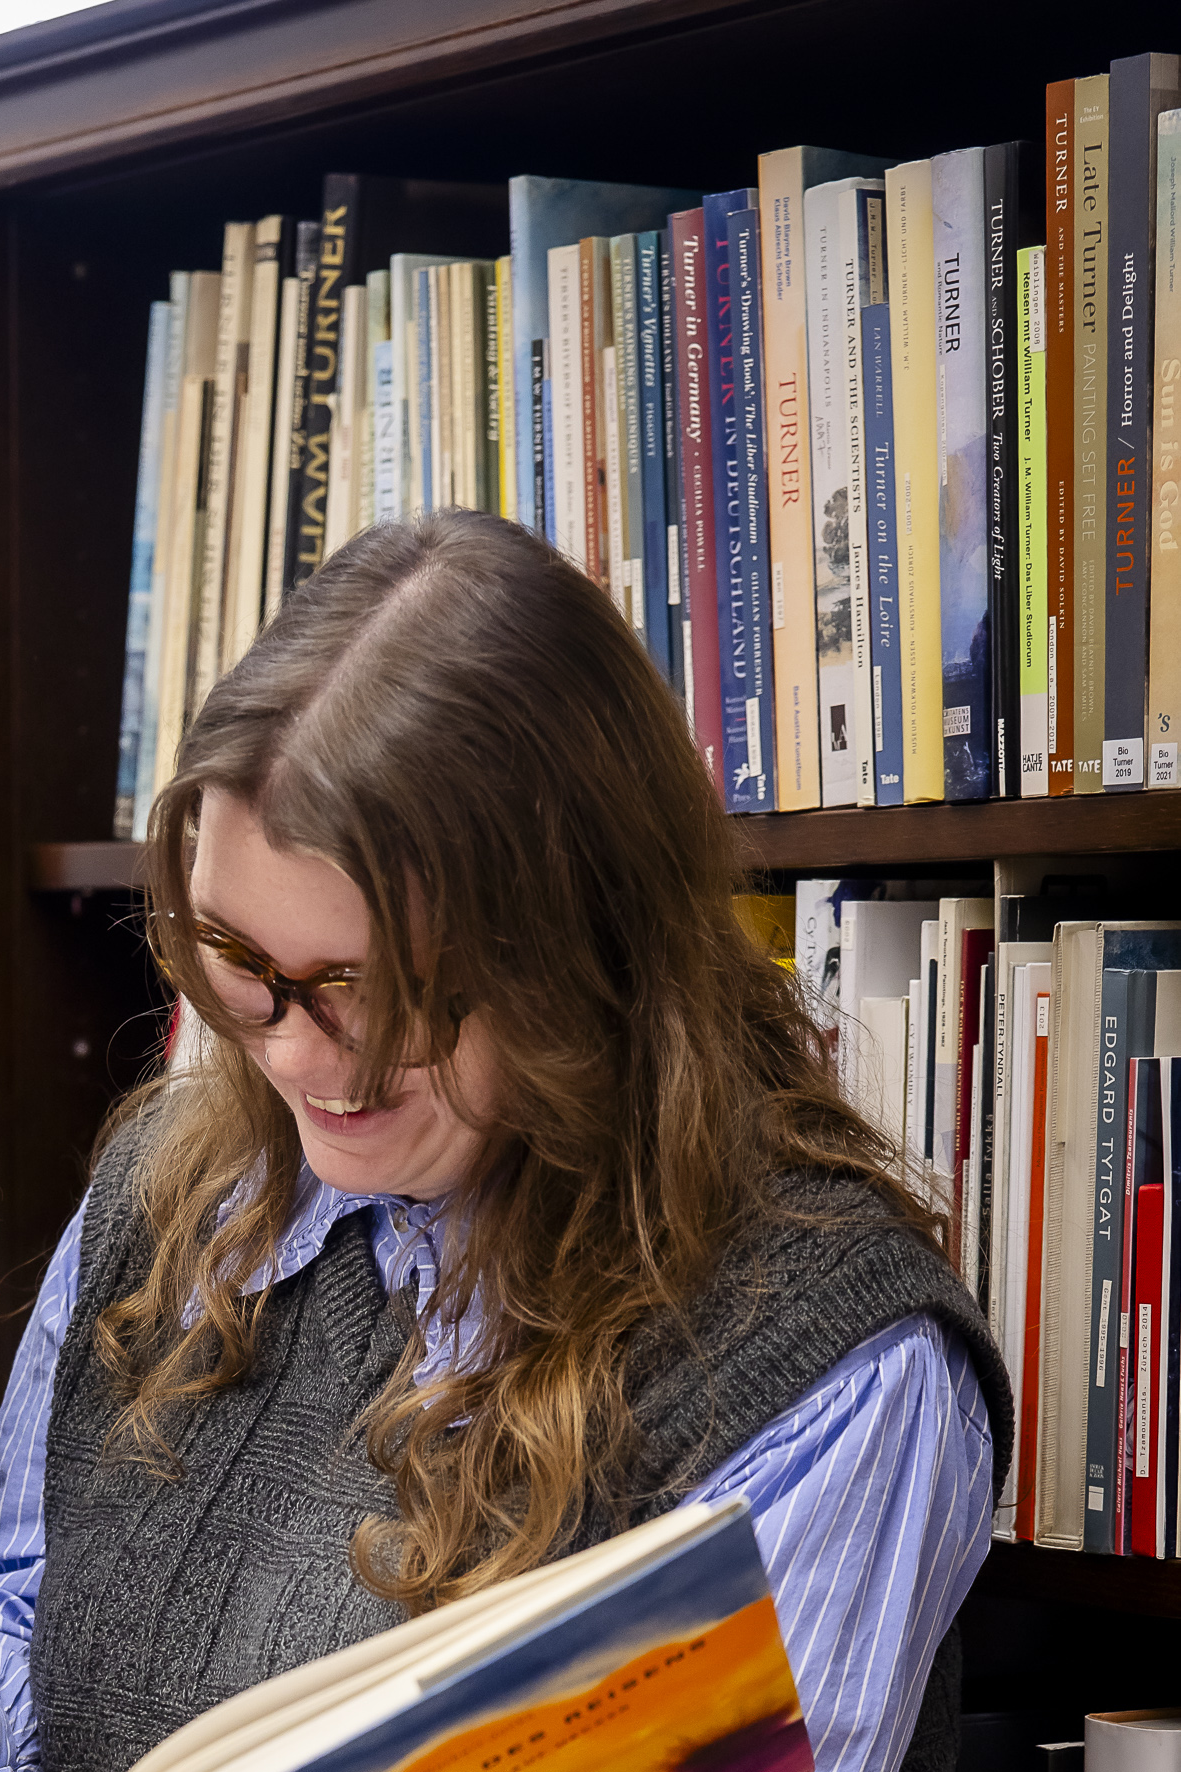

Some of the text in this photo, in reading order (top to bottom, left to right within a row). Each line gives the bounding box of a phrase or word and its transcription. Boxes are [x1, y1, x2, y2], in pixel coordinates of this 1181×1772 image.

[1080, 114, 1104, 126] Exhibition
[1082, 106, 1091, 117] The
[1055, 112, 1068, 214] TURNER
[774, 224, 783, 260] Albrecht
[783, 196, 792, 288] David Blayney Brown
[990, 198, 1004, 292] TURNER
[1168, 156, 1178, 293] Joseph Mallord William Turner
[739, 228, 751, 289] Turner's
[775, 261, 784, 302] Schröder
[1032, 252, 1041, 314] Waiblingen
[308, 206, 348, 406] TURNER
[641, 244, 657, 389] Turner's Vignettes
[819, 225, 832, 408] TURNER IN INDIANAPOLIS
[901, 272, 910, 348] WILLIAM TURNER
[943, 252, 960, 354] TURNER
[991, 318, 1005, 421] SCHOBER
[1081, 140, 1103, 542] Late Turner PAINTING SET FREE
[682, 235, 706, 574] Turner in Germany POWELL
[744, 402, 758, 433] The
[1115, 252, 1137, 596] TURNER Horror and Delight
[746, 435, 760, 471] Liber
[778, 371, 800, 509] TURNER
[845, 258, 865, 669] TURNER AND THE SCIENTISTS James Hamilton
[992, 432, 1004, 461] Two
[1157, 357, 1181, 554] Sun is God
[873, 326, 894, 648] IAN WARRELL Turner on the Loire
[992, 465, 1004, 522] Creators
[1022, 271, 1034, 668] Reisen mit William Turner M. William Turner: Das Liber Studiorum
[748, 473, 762, 545] Studiorum
[992, 525, 1004, 539] of
[1058, 528, 1065, 543] BY
[726, 459, 748, 679] DEUTSCHLAND
[992, 544, 1005, 581] Light
[1058, 547, 1066, 583] DAVID
[751, 571, 760, 622] GILLIAN
[1058, 587, 1066, 630] SOLKIN
[1087, 607, 1095, 636] DAVID
[753, 626, 763, 696] FORRESTER
[1049, 621, 1057, 663] London
[792, 684, 803, 791] Bank Austria Kunstforum
[1022, 752, 1043, 766] HATJE
[1051, 759, 1073, 773] TATE
[1112, 756, 1134, 768] Turner
[1117, 745, 1129, 757] Bio
[1154, 759, 1173, 770] Turner
[1158, 748, 1169, 759] Bio
[861, 759, 869, 785] Tate
[881, 773, 900, 785] Tate
[1022, 763, 1043, 775] CANTZ
[1077, 759, 1101, 774] TATE
[1115, 767, 1132, 779] 2019
[1156, 770, 1171, 782] 2021
[1038, 1005, 1046, 1029] 2013
[1098, 1015, 1117, 1241] EDGARD TYTGAT
[1125, 1108, 1135, 1196] Dimitris Tzamouranis
[982, 1113, 995, 1217] Salla Tykkä
[1140, 1305, 1149, 1475] D. Tzamouranis. Zürich 2014
